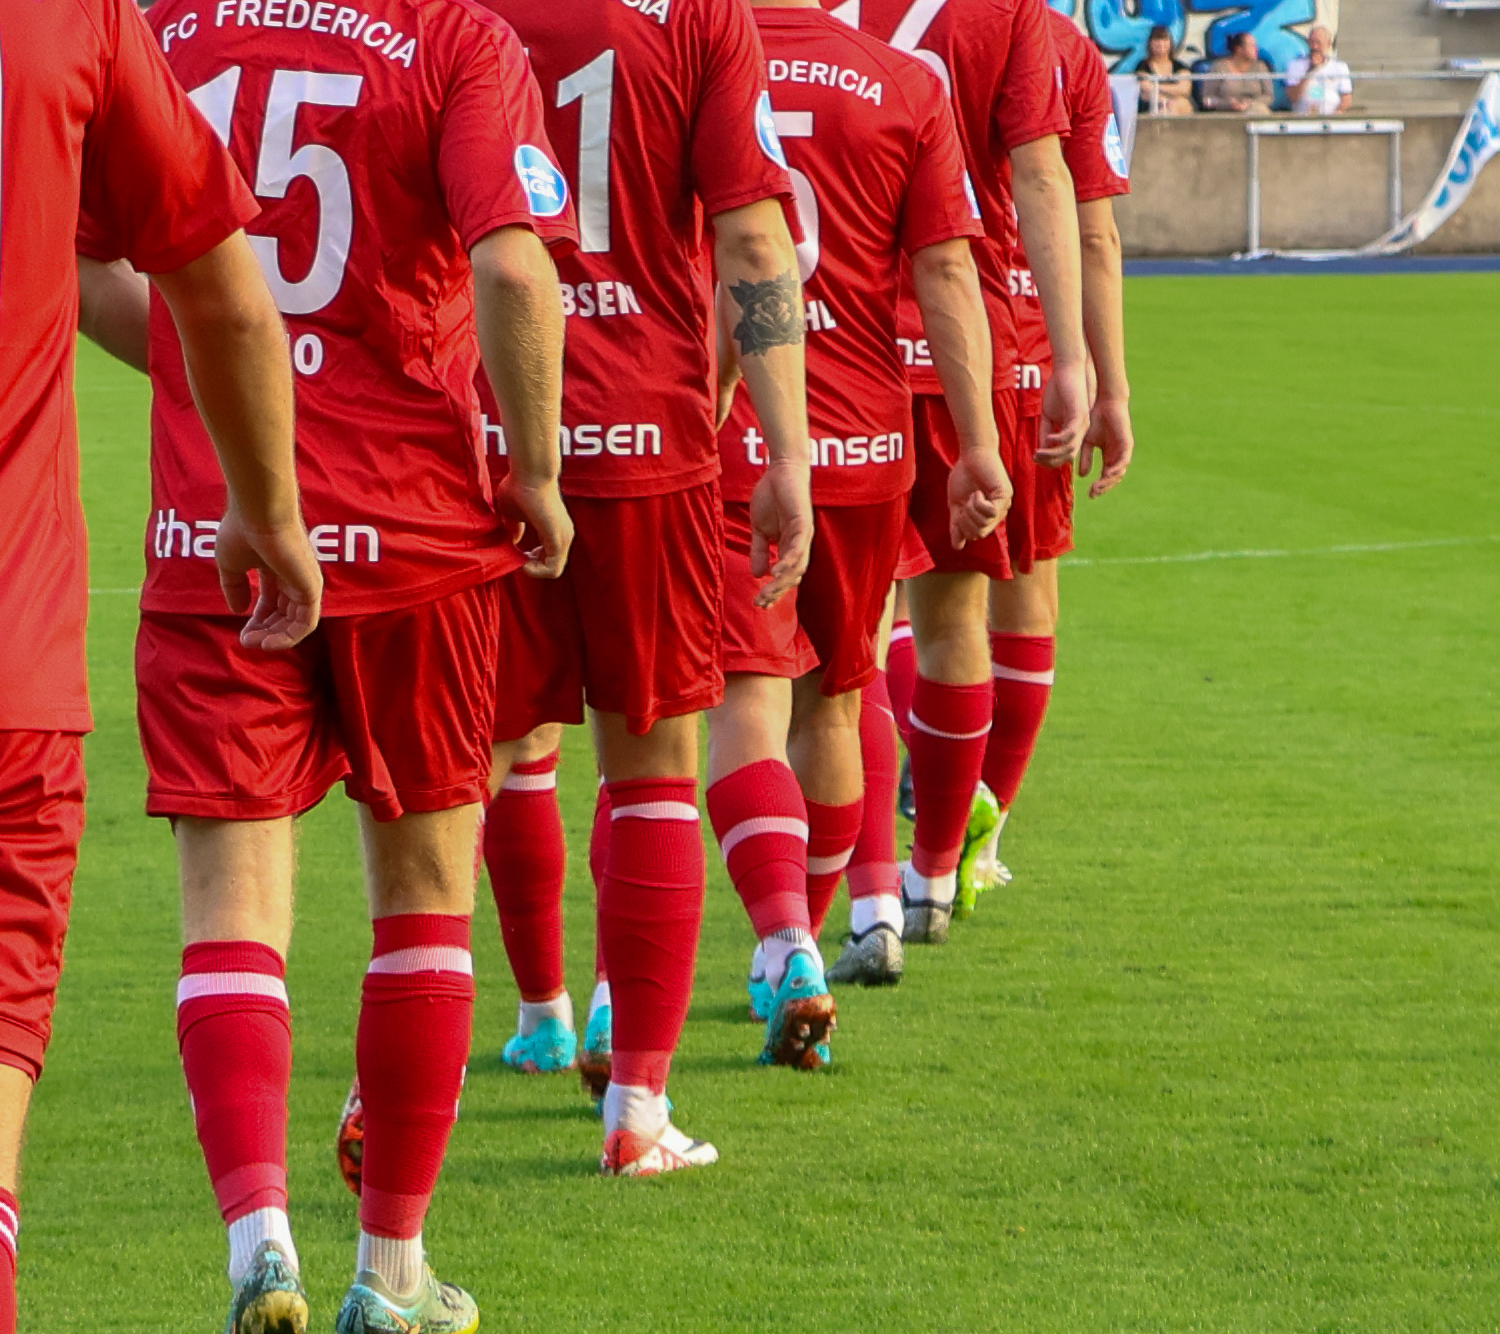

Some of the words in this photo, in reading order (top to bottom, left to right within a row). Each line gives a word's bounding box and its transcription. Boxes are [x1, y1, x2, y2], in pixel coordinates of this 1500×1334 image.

[162, 12, 199, 54] FC
[768, 59, 884, 106] DERICIA
[742, 426, 904, 467] tnsen
[154, 508, 380, 563] thaen
